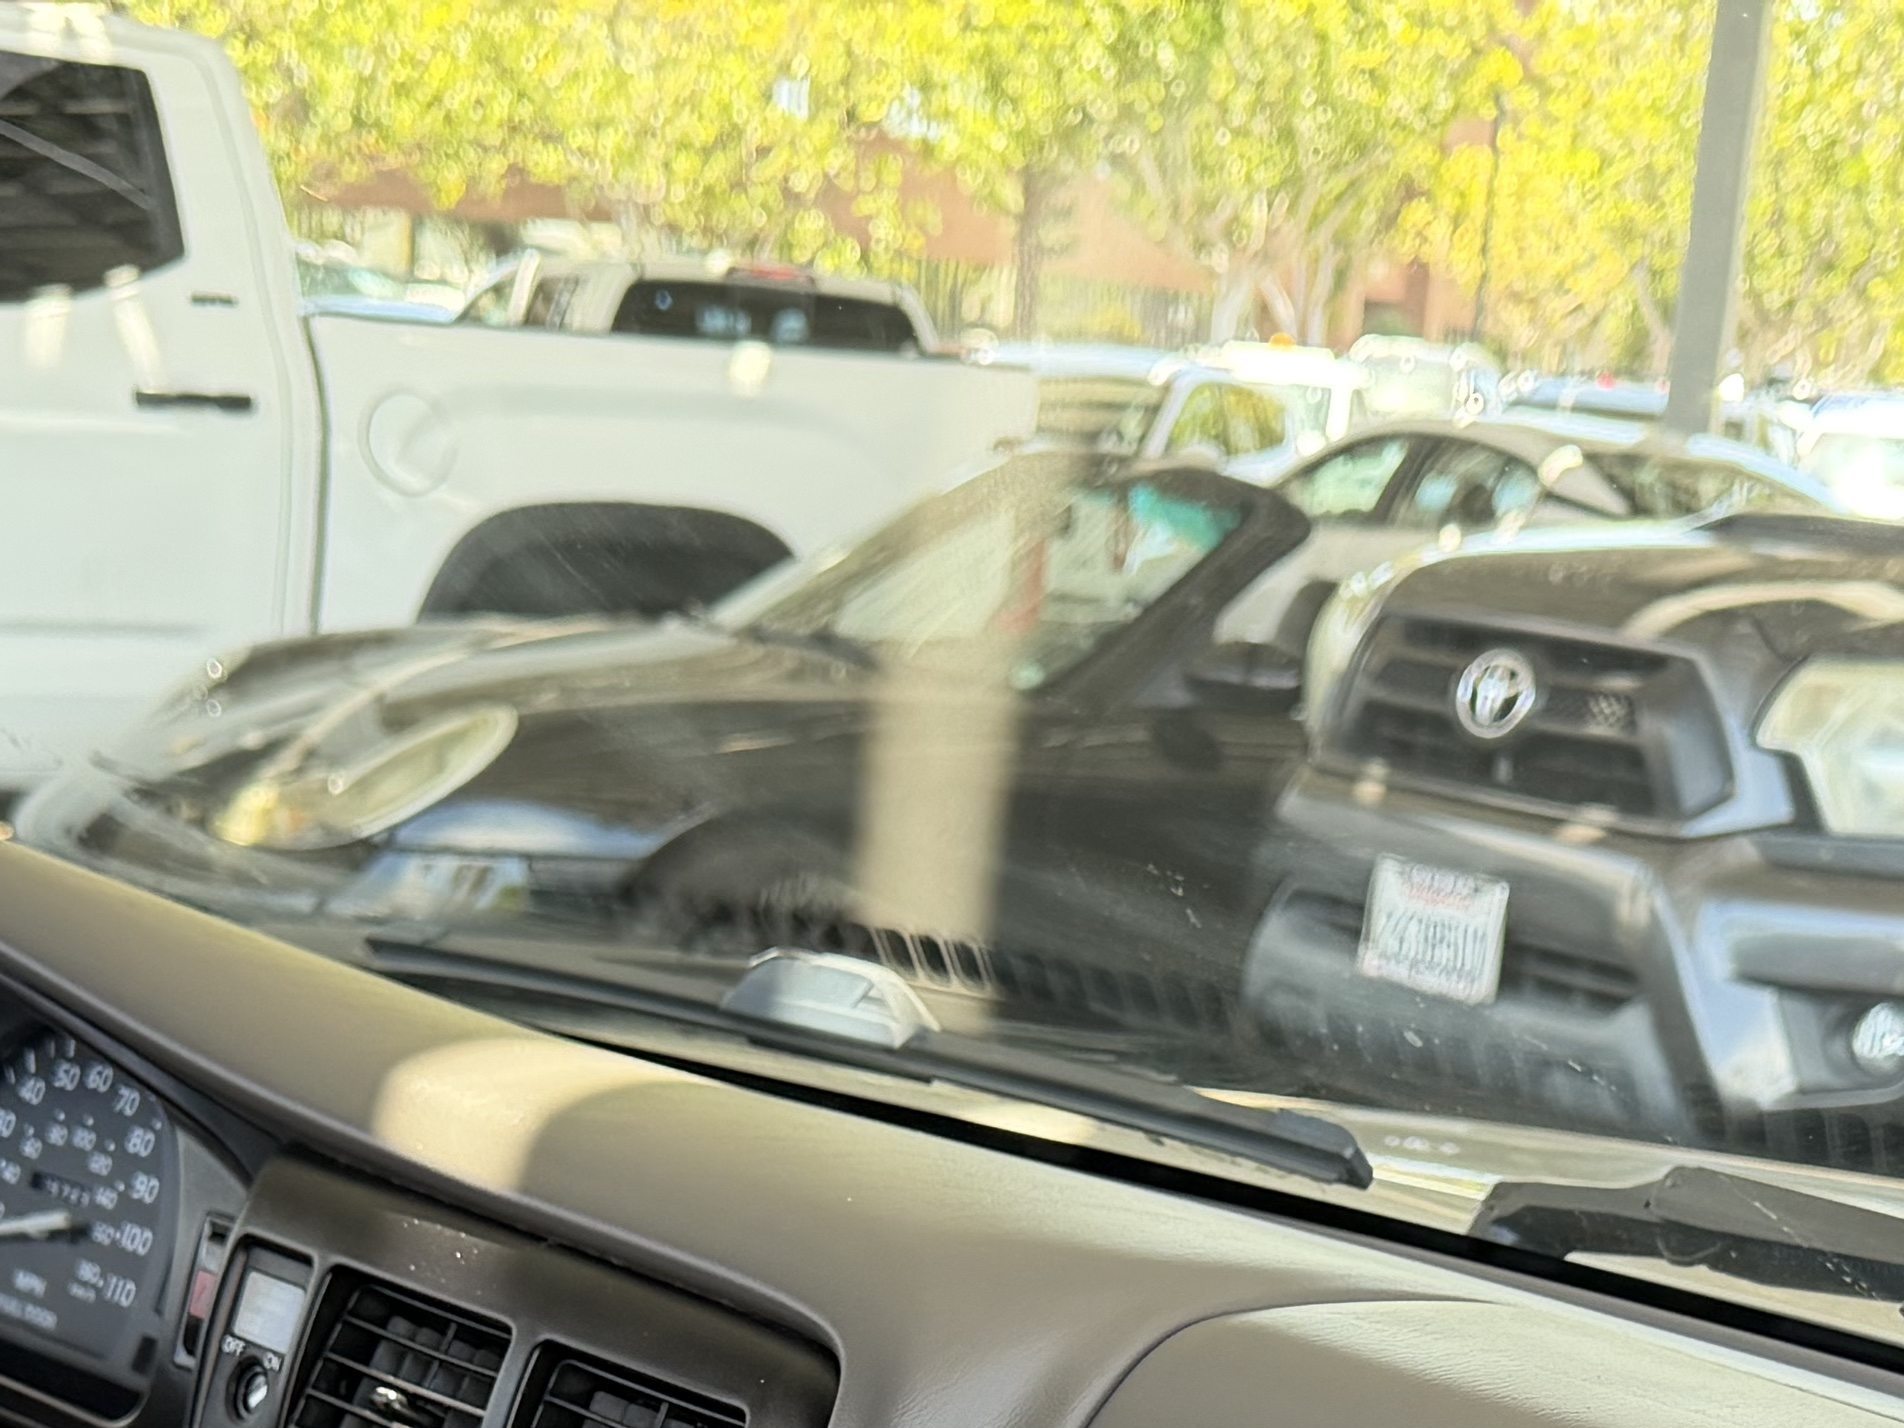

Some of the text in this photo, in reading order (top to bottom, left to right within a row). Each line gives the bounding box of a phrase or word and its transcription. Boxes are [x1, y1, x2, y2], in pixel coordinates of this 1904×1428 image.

[18, 1075, 46, 1106] 40
[53, 1059, 81, 1091] 50
[84, 1062, 114, 1093] 60
[113, 1084, 140, 1117] 70
[125, 1125, 155, 1158] 80
[130, 1171, 159, 1205] 90
[120, 1222, 153, 1256] 100
[104, 1272, 136, 1308] 110
[222, 1334, 245, 1357] OFF
[263, 1352, 282, 1372] ON
